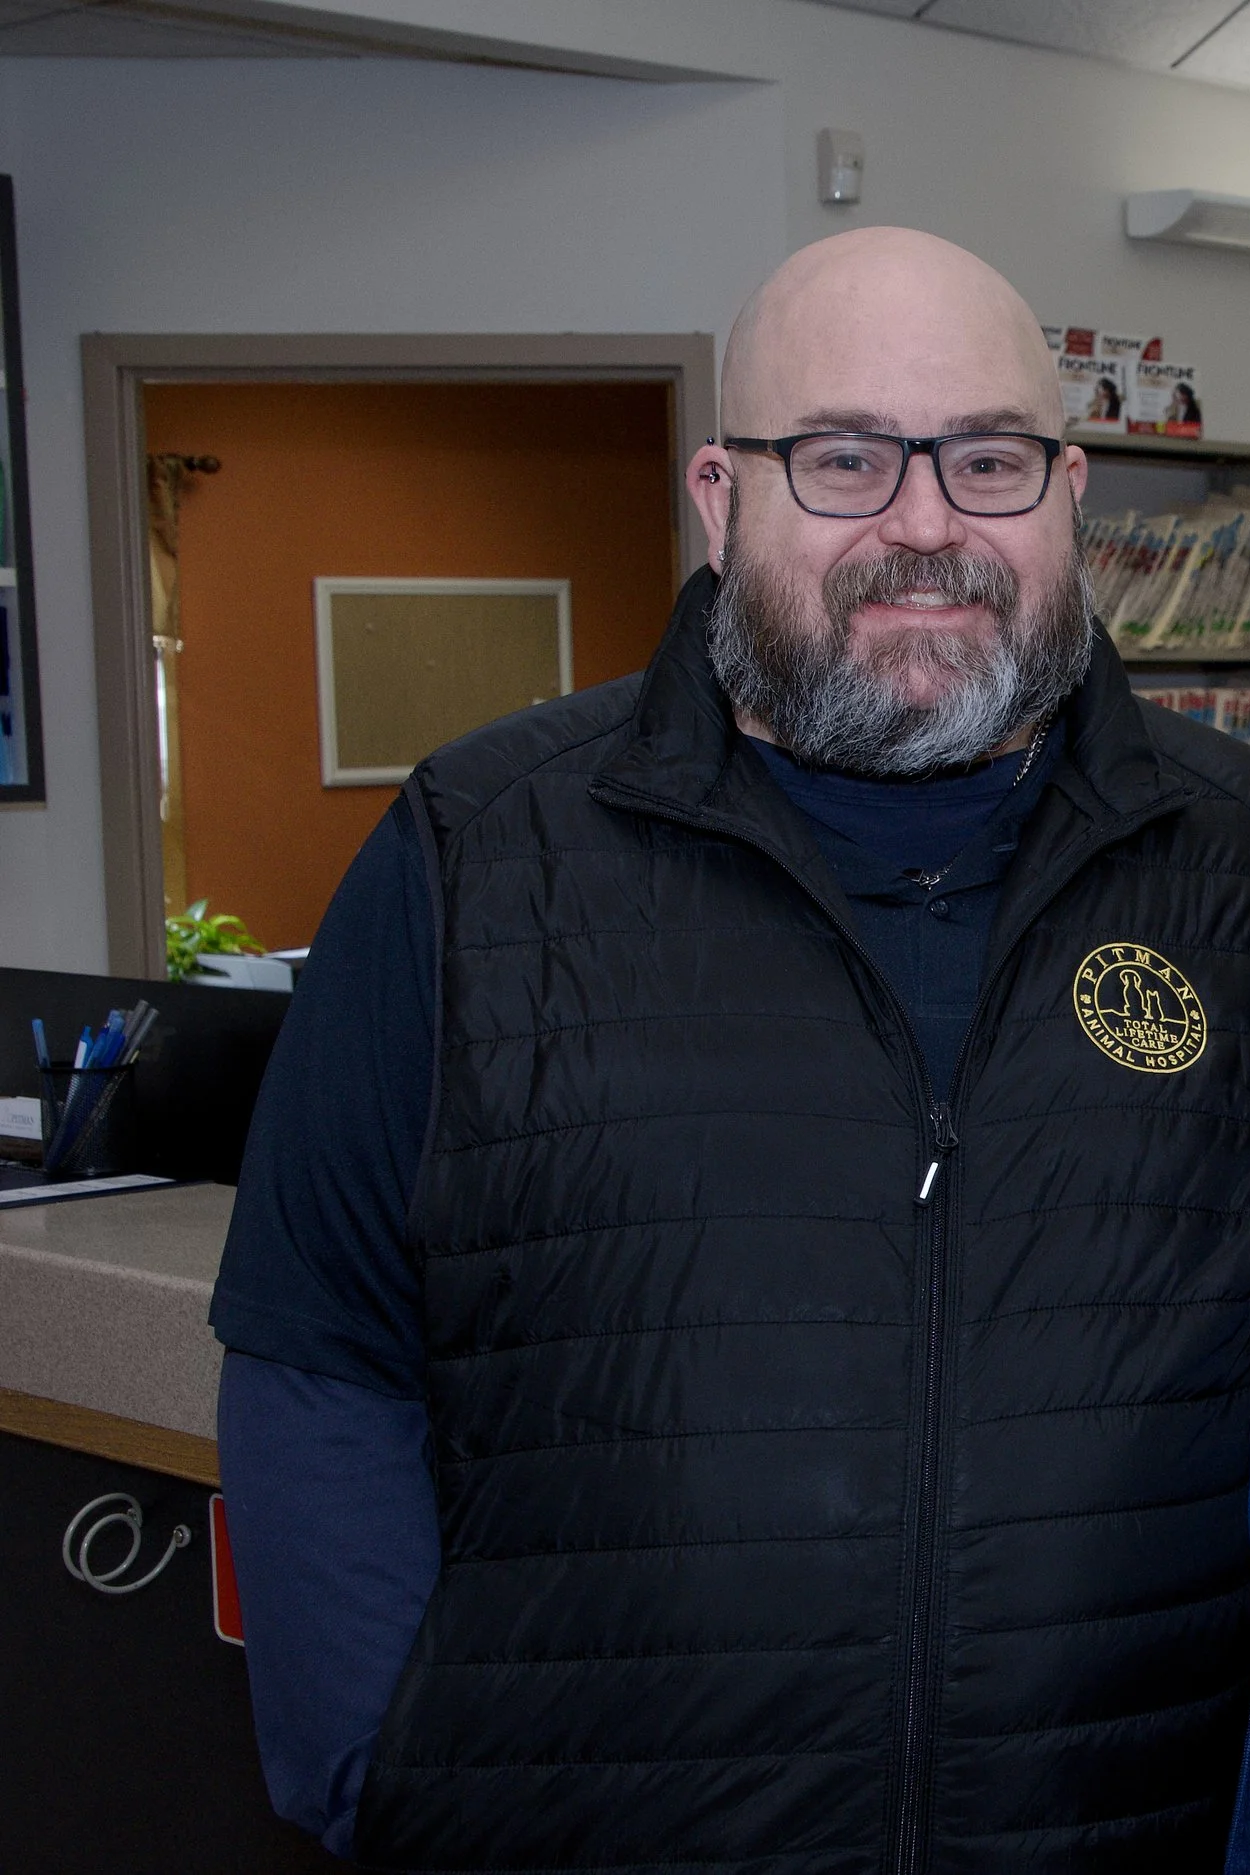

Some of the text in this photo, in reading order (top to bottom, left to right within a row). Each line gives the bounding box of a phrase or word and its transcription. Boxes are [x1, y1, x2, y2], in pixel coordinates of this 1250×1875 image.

[1082, 947, 1194, 1000] PITMAN
[1124, 1019, 1168, 1034] TOTAL
[1081, 1008, 1202, 1068] ANIMAL HOSPITAL
[1115, 1027, 1179, 1044] LIFETIME
[1131, 1038, 1165, 1050] CARE
